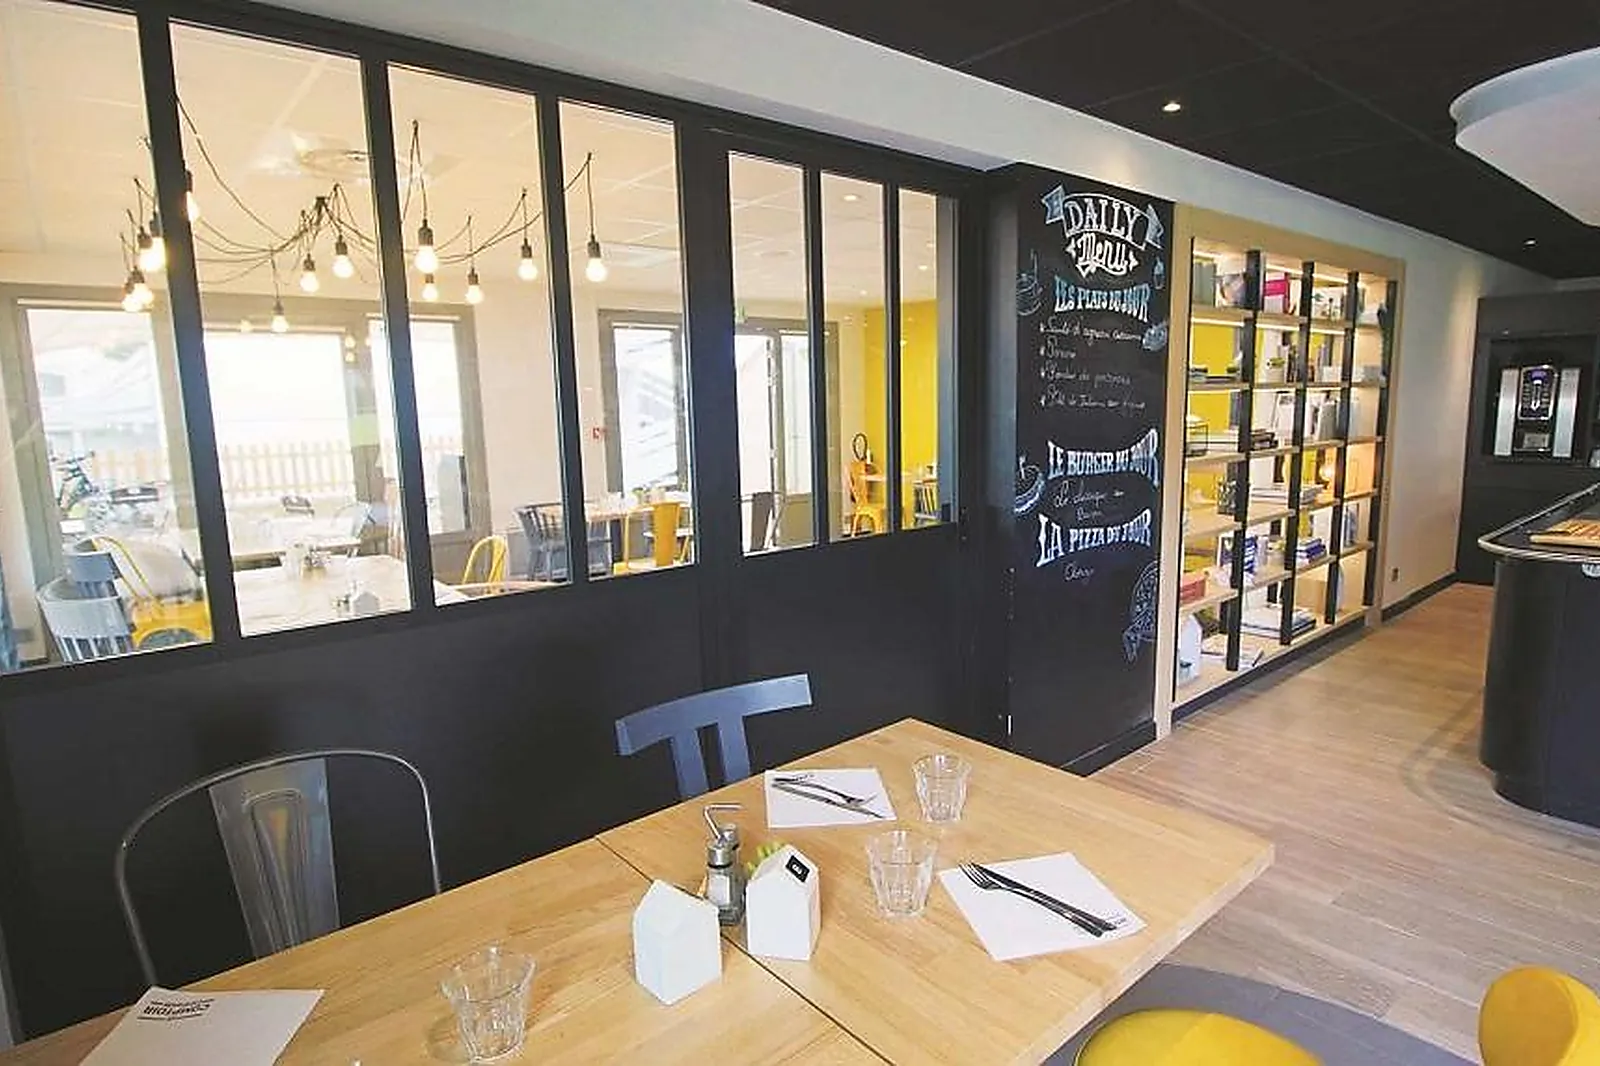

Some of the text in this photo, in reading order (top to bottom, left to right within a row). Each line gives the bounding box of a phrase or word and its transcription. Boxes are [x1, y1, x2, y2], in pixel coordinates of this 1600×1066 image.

[1065, 198, 1142, 242] DAILY
[1076, 232, 1129, 277] Menu
[1054, 275, 1075, 313] LES
[1047, 440, 1064, 479] LE
[1066, 450, 1114, 476] BURGER
[1036, 512, 1065, 567] LA
[1068, 526, 1105, 552] PIZZA
